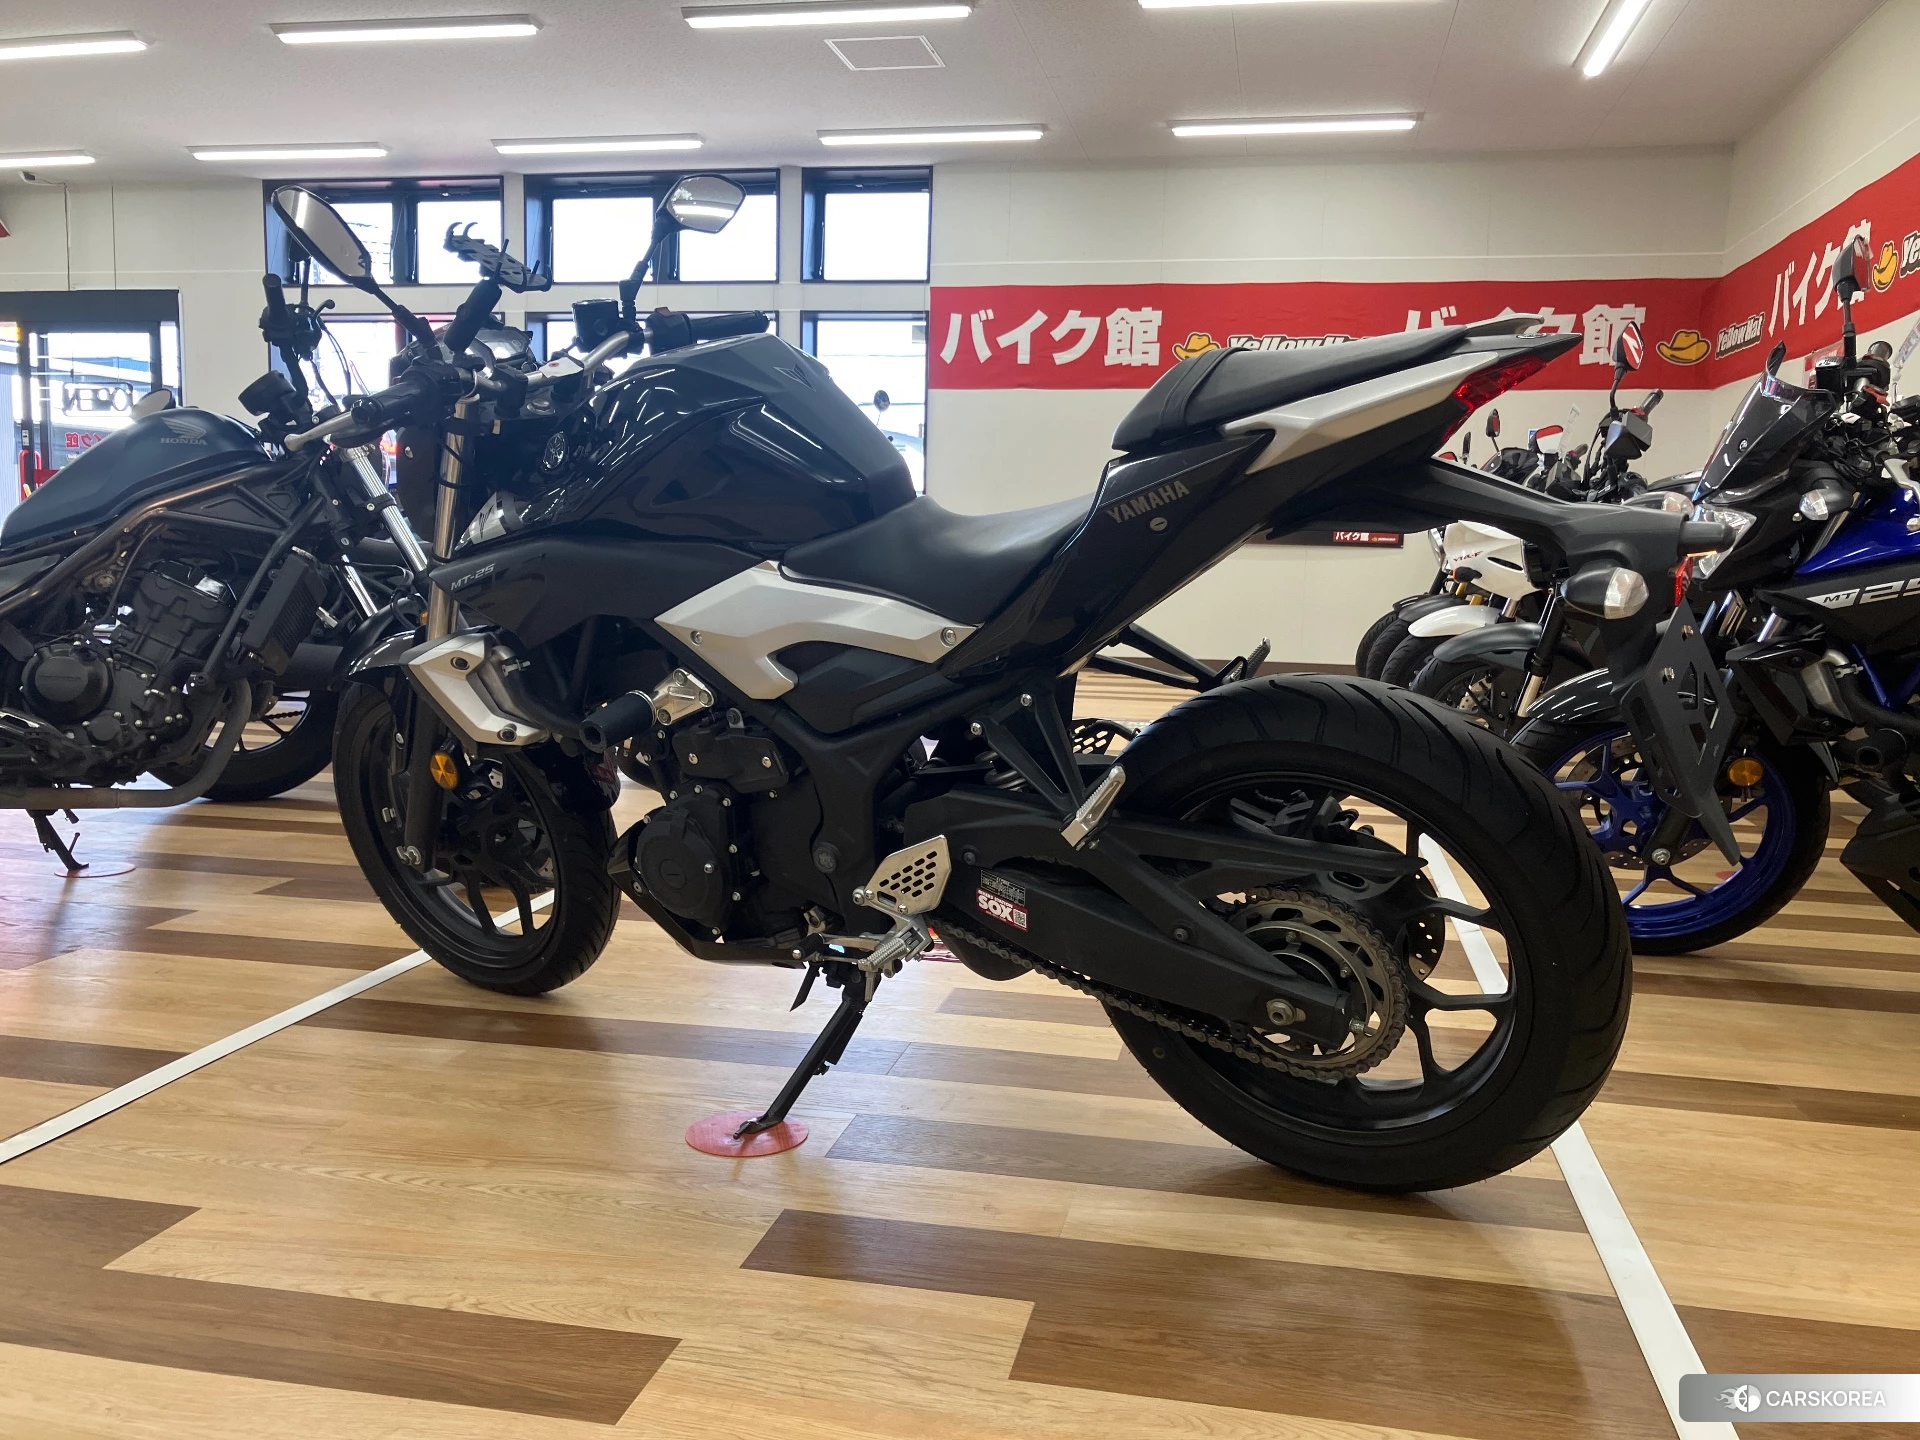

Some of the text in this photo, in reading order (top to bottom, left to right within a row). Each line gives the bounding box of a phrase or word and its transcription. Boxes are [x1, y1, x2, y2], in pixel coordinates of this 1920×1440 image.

[940, 307, 1162, 366] バイク館
[160, 437, 207, 445] HONDA
[1106, 480, 1190, 524] YAMAHA
[451, 563, 495, 590] MT-25
[1822, 591, 1858, 603] MT
[978, 895, 1014, 922] SOX
